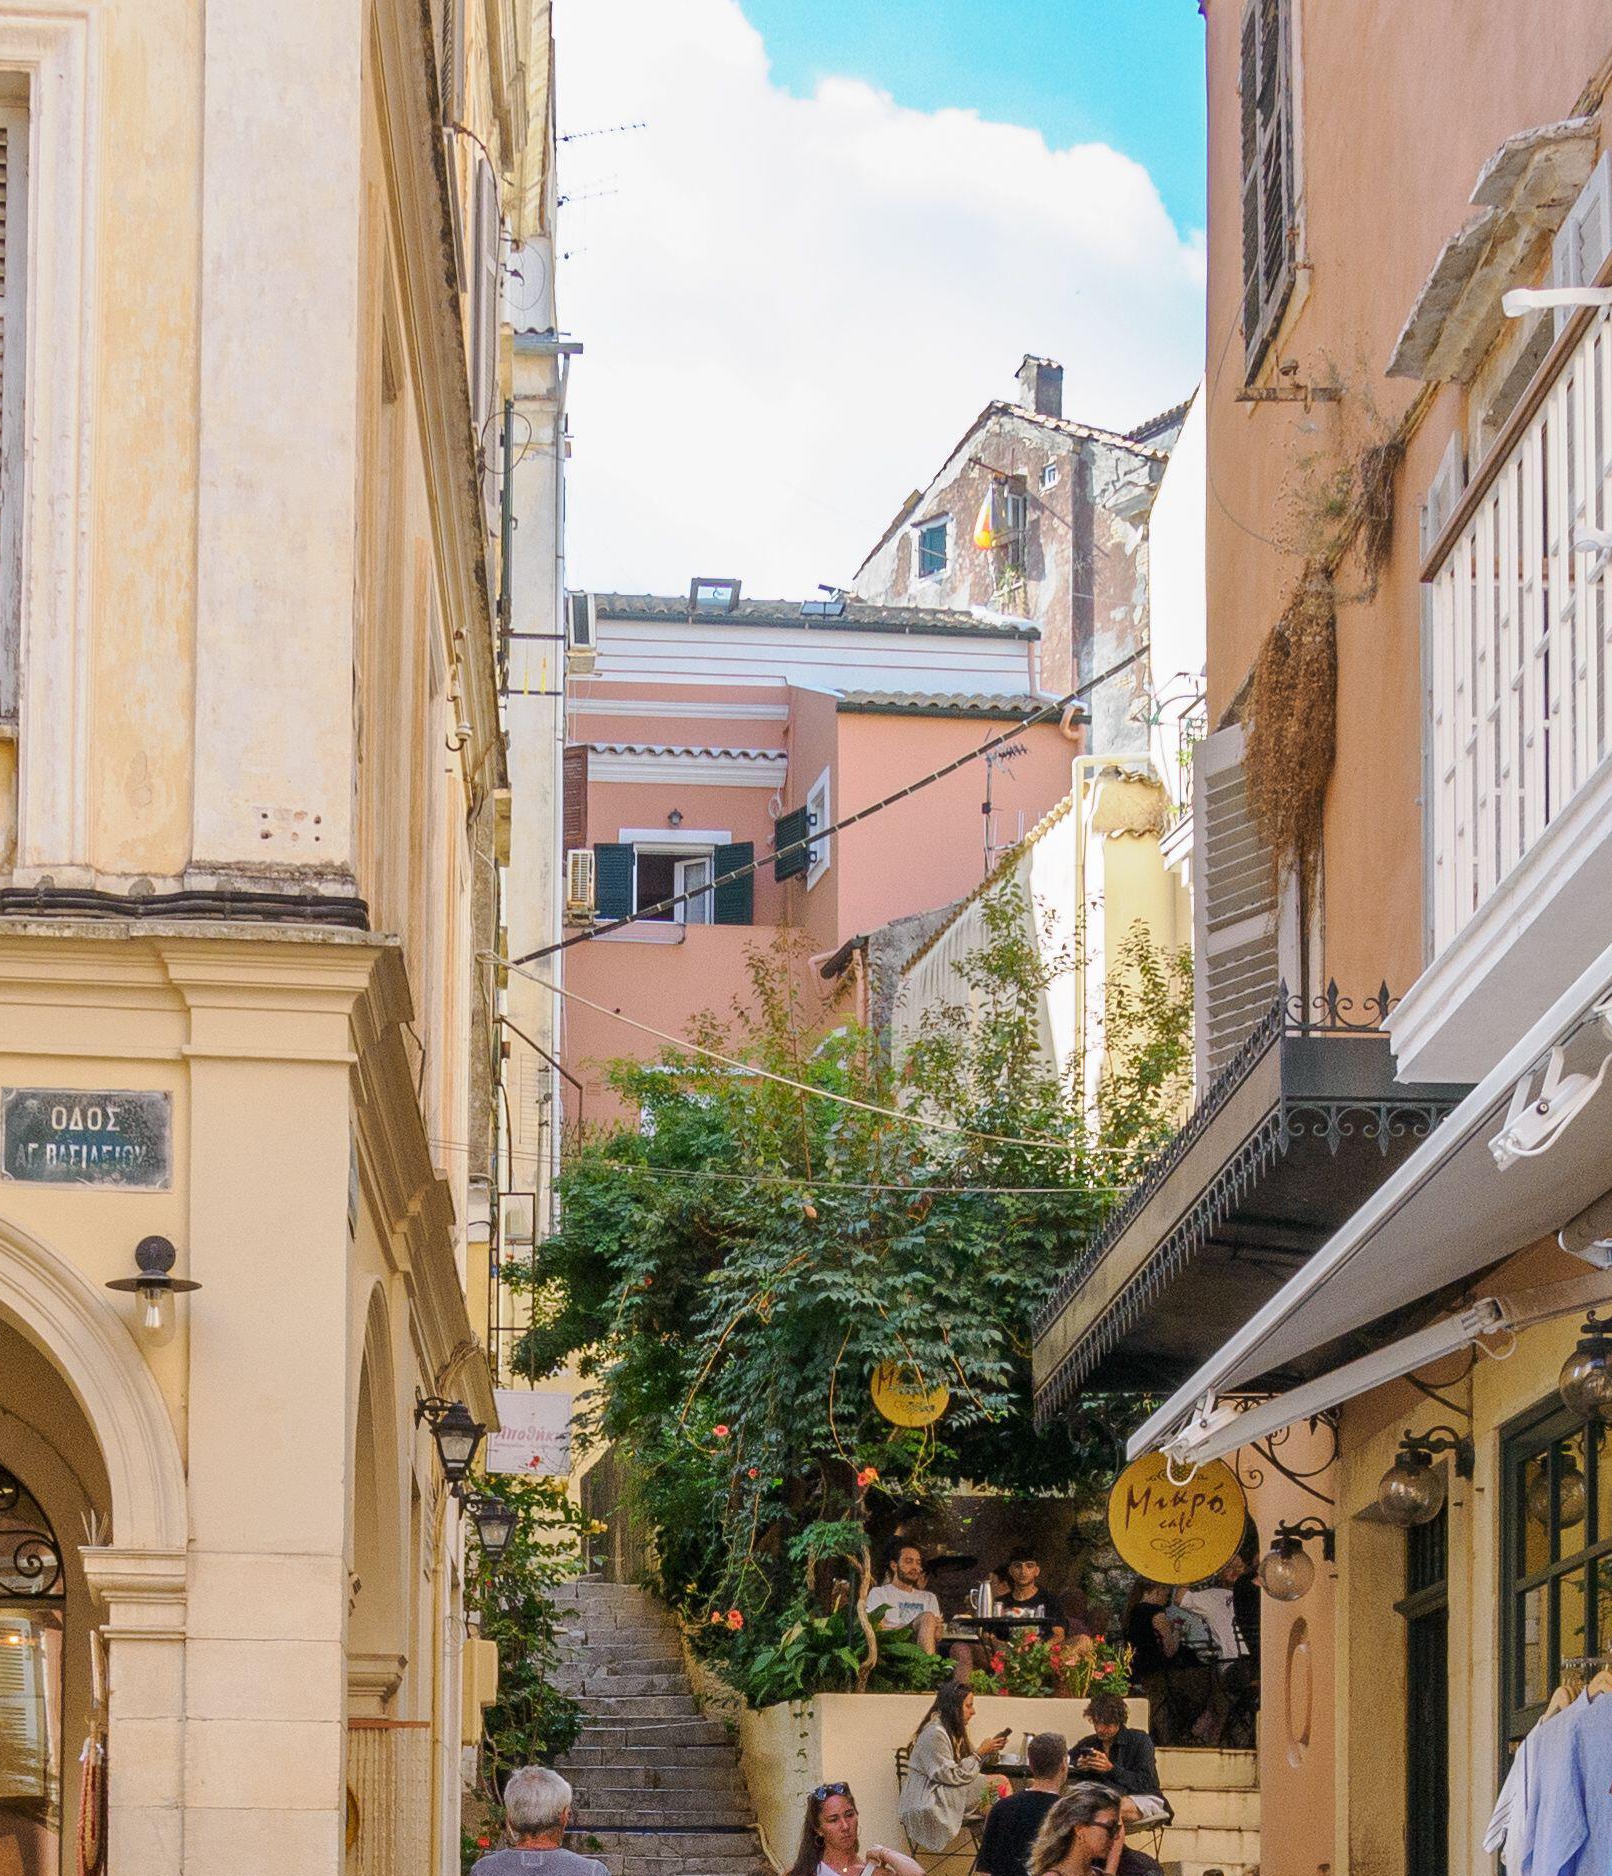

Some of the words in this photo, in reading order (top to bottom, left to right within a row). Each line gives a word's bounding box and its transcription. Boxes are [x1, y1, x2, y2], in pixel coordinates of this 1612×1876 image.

[51, 1106, 121, 1131] ΟΔΟΣ
[495, 1425, 555, 1442] Αποθήκ
[1125, 1481, 1227, 1531] Μικρό
